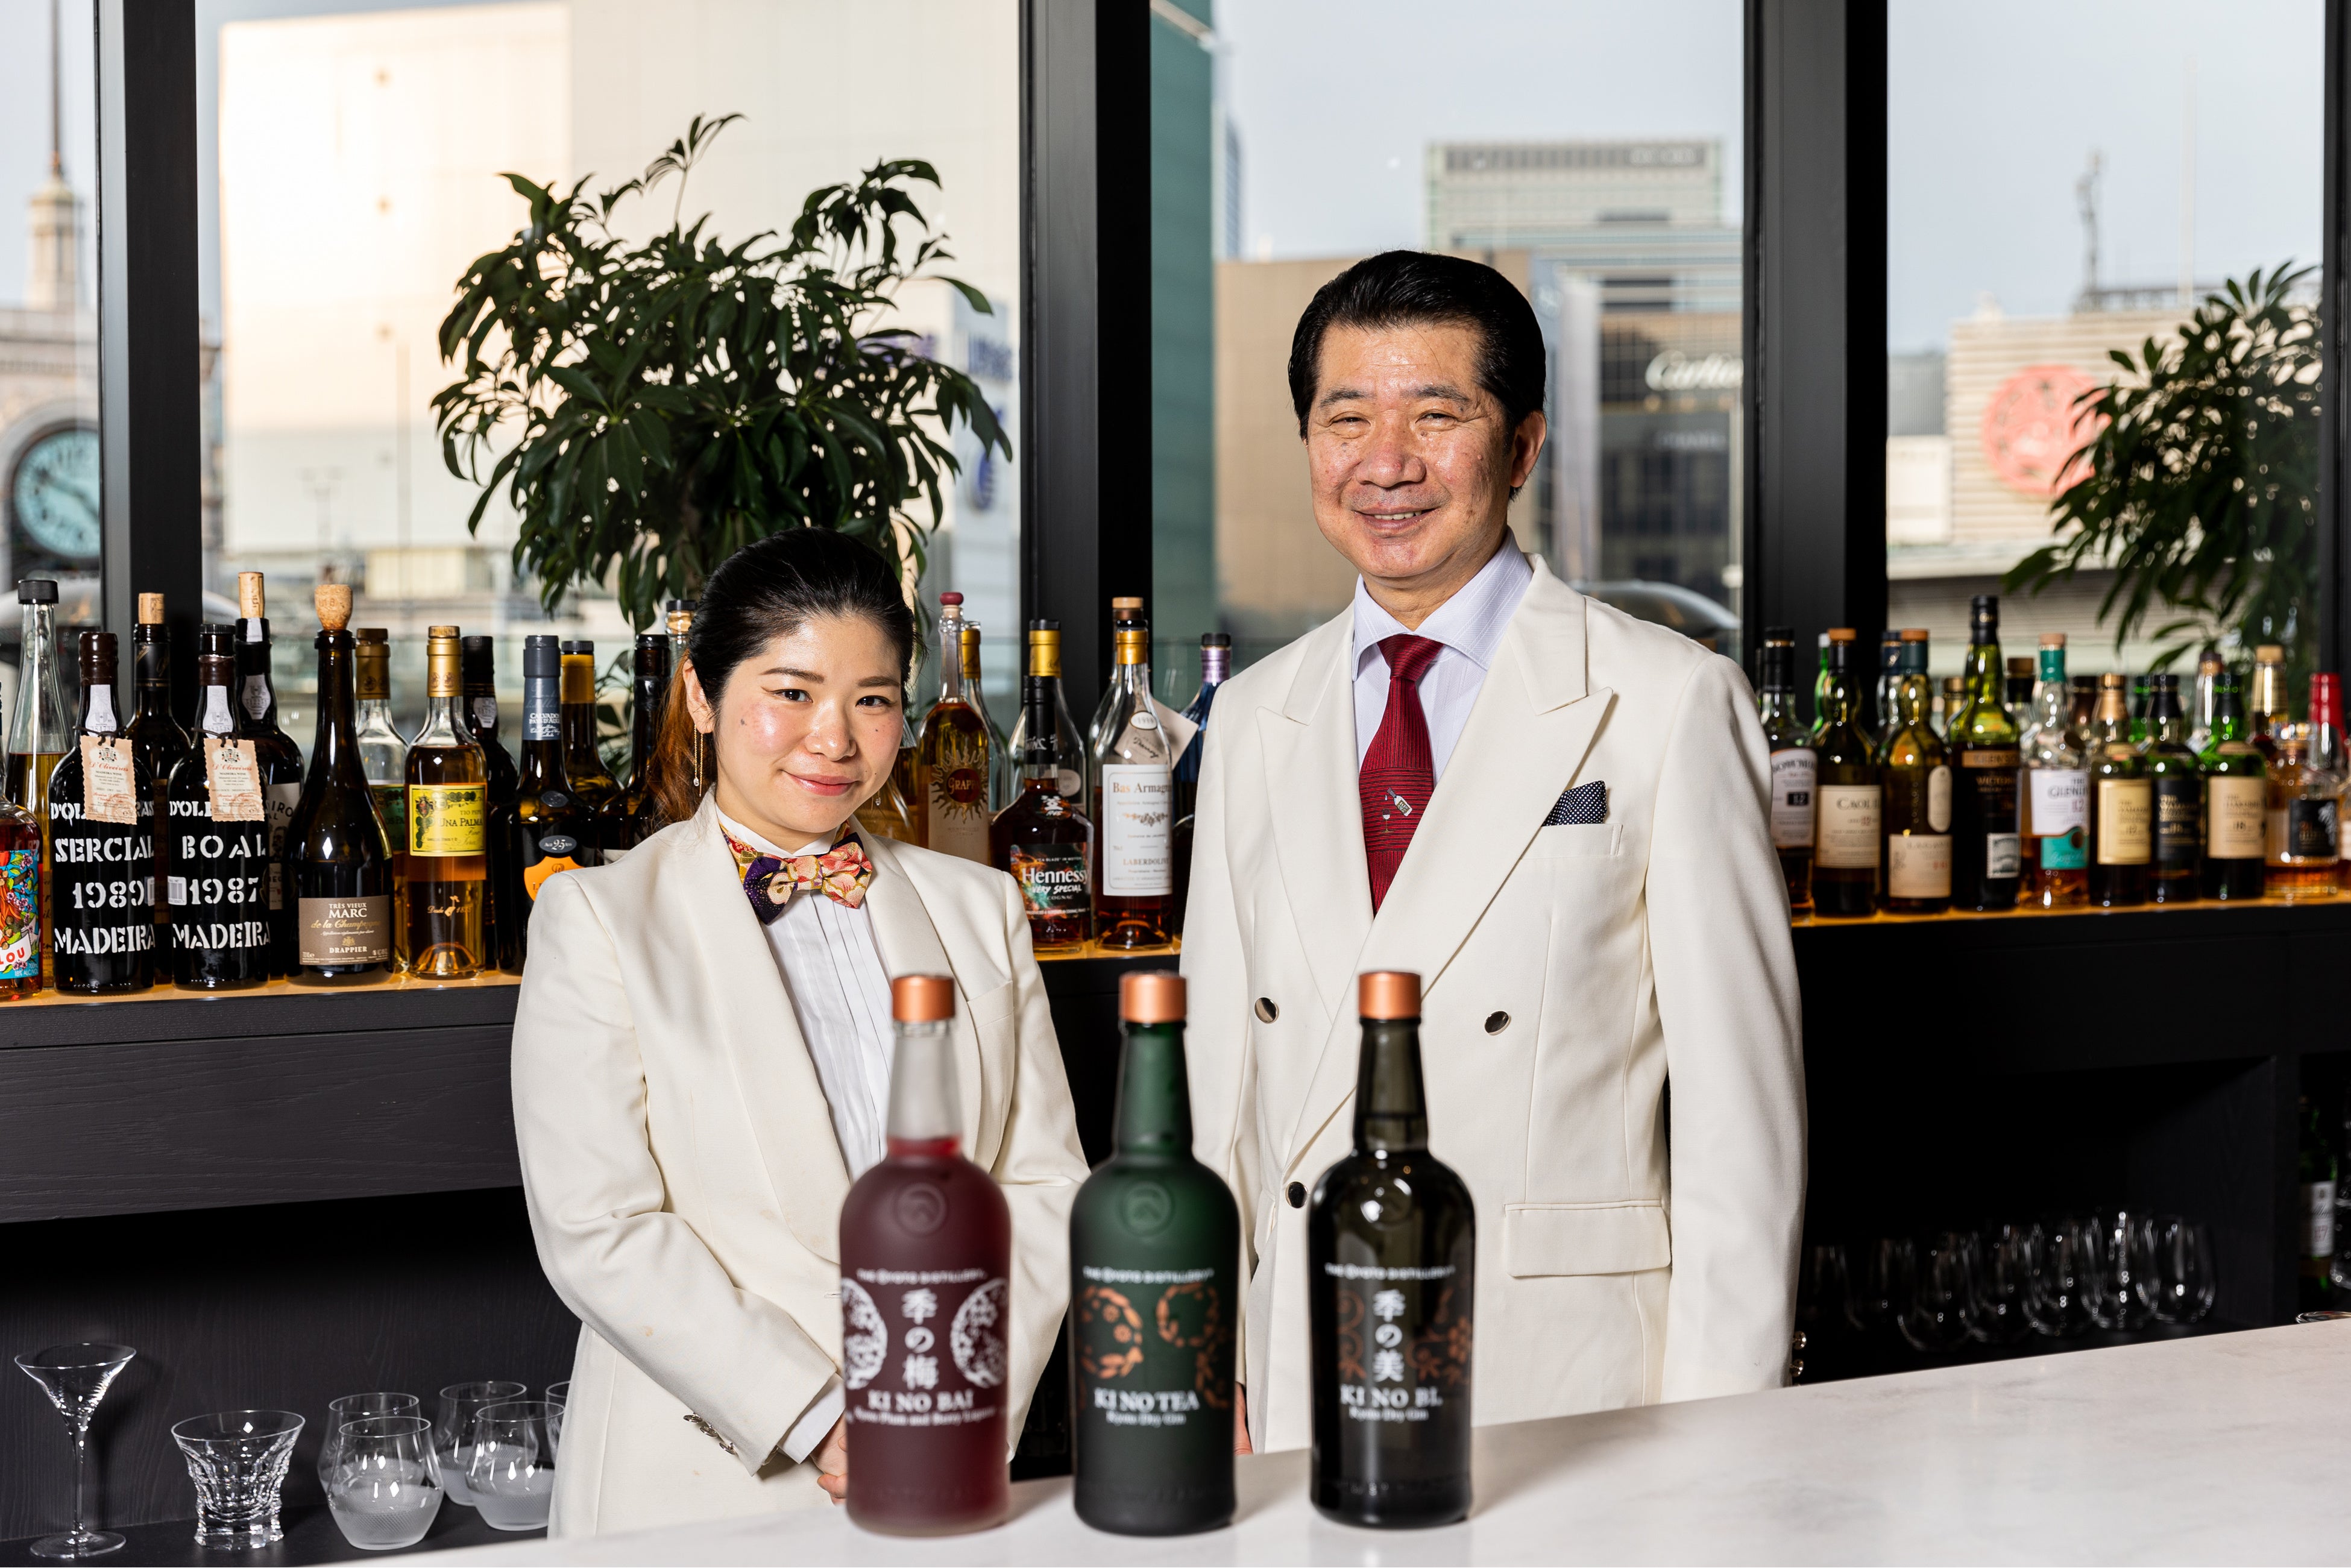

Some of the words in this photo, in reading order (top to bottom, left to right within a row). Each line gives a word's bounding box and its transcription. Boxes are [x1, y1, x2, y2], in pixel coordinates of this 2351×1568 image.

[1113, 782, 1130, 793] Bas
[439, 817, 458, 827] UNA
[55, 836, 154, 863] SERCIAL
[182, 834, 266, 859] BOAL
[552, 839, 566, 850] 25
[1022, 867, 1087, 884] Hennessy
[72, 880, 145, 908] 1989
[189, 877, 259, 904] 1987
[1031, 884, 1051, 895] VERY
[1053, 884, 1083, 895] SPECIAL
[311, 920, 321, 928] de
[323, 919, 332, 928] la
[329, 908, 367, 919] MARC
[54, 924, 156, 954] MADEIRA
[172, 921, 271, 949] MADEIRA
[1373, 1289, 1406, 1382] 季の美
[868, 1390, 891, 1411] KI
[895, 1391, 932, 1412] NO
[1094, 1387, 1116, 1409] KI
[1119, 1390, 1154, 1412] NO
[1154, 1390, 1200, 1412] TEA
[1341, 1384, 1365, 1406] KI
[1371, 1387, 1409, 1408] NO
